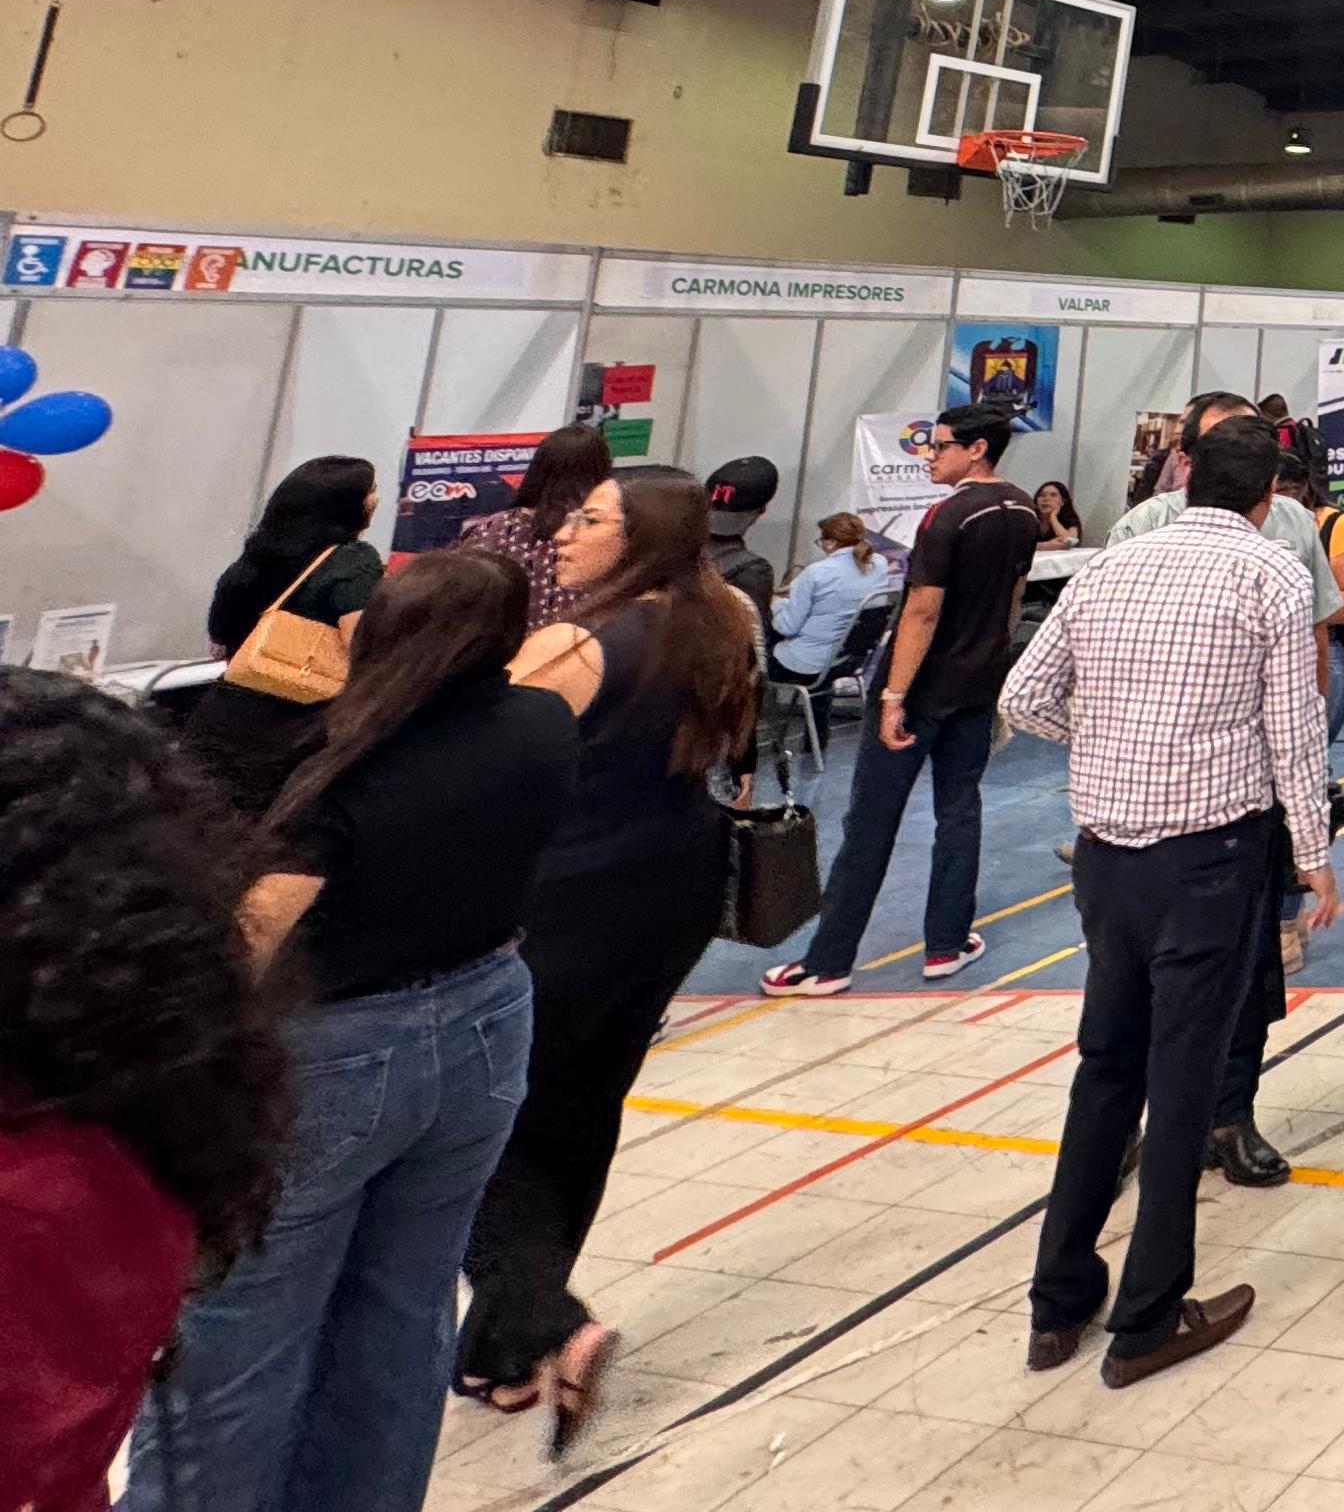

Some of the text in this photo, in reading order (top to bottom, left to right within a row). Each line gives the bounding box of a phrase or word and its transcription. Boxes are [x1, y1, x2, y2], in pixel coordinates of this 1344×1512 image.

[236, 250, 464, 279] ANUFACTURAS
[671, 277, 905, 302] CARMONA IMPRESORES
[1058, 297, 1111, 312] VALPAR
[414, 449, 482, 466] VACANTES
[870, 464, 932, 475] carmo
